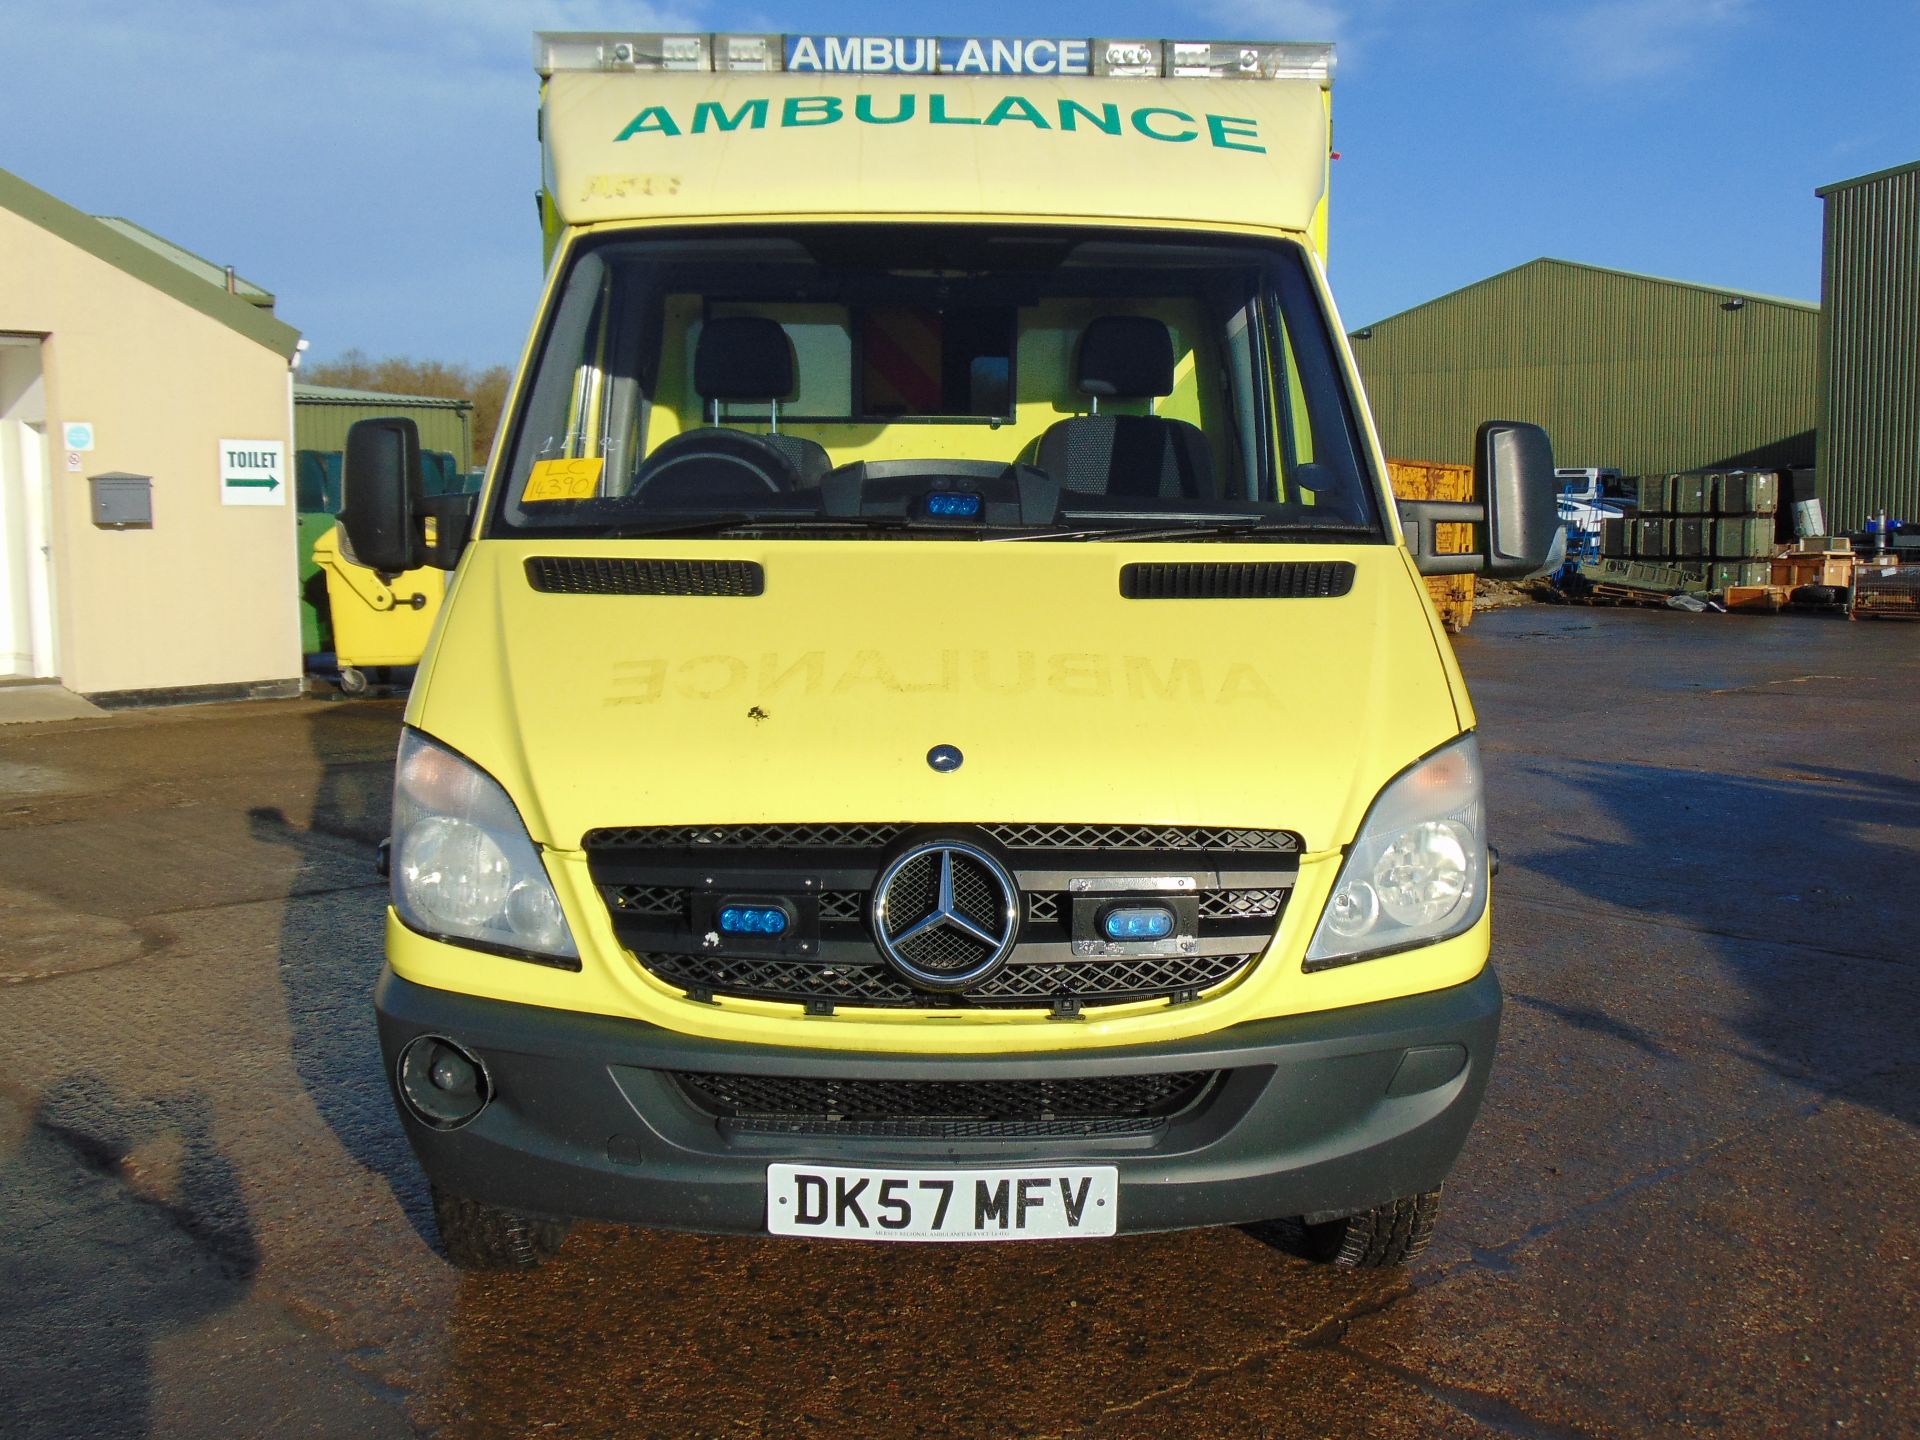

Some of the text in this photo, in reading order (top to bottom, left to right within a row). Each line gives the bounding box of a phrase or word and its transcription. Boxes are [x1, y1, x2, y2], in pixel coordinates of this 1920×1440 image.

[788, 37, 1087, 73] AMBULANCE
[615, 93, 1268, 154] AMBULANCE
[227, 451, 277, 468] TOILET
[794, 1174, 1092, 1231] DK57 MFV
